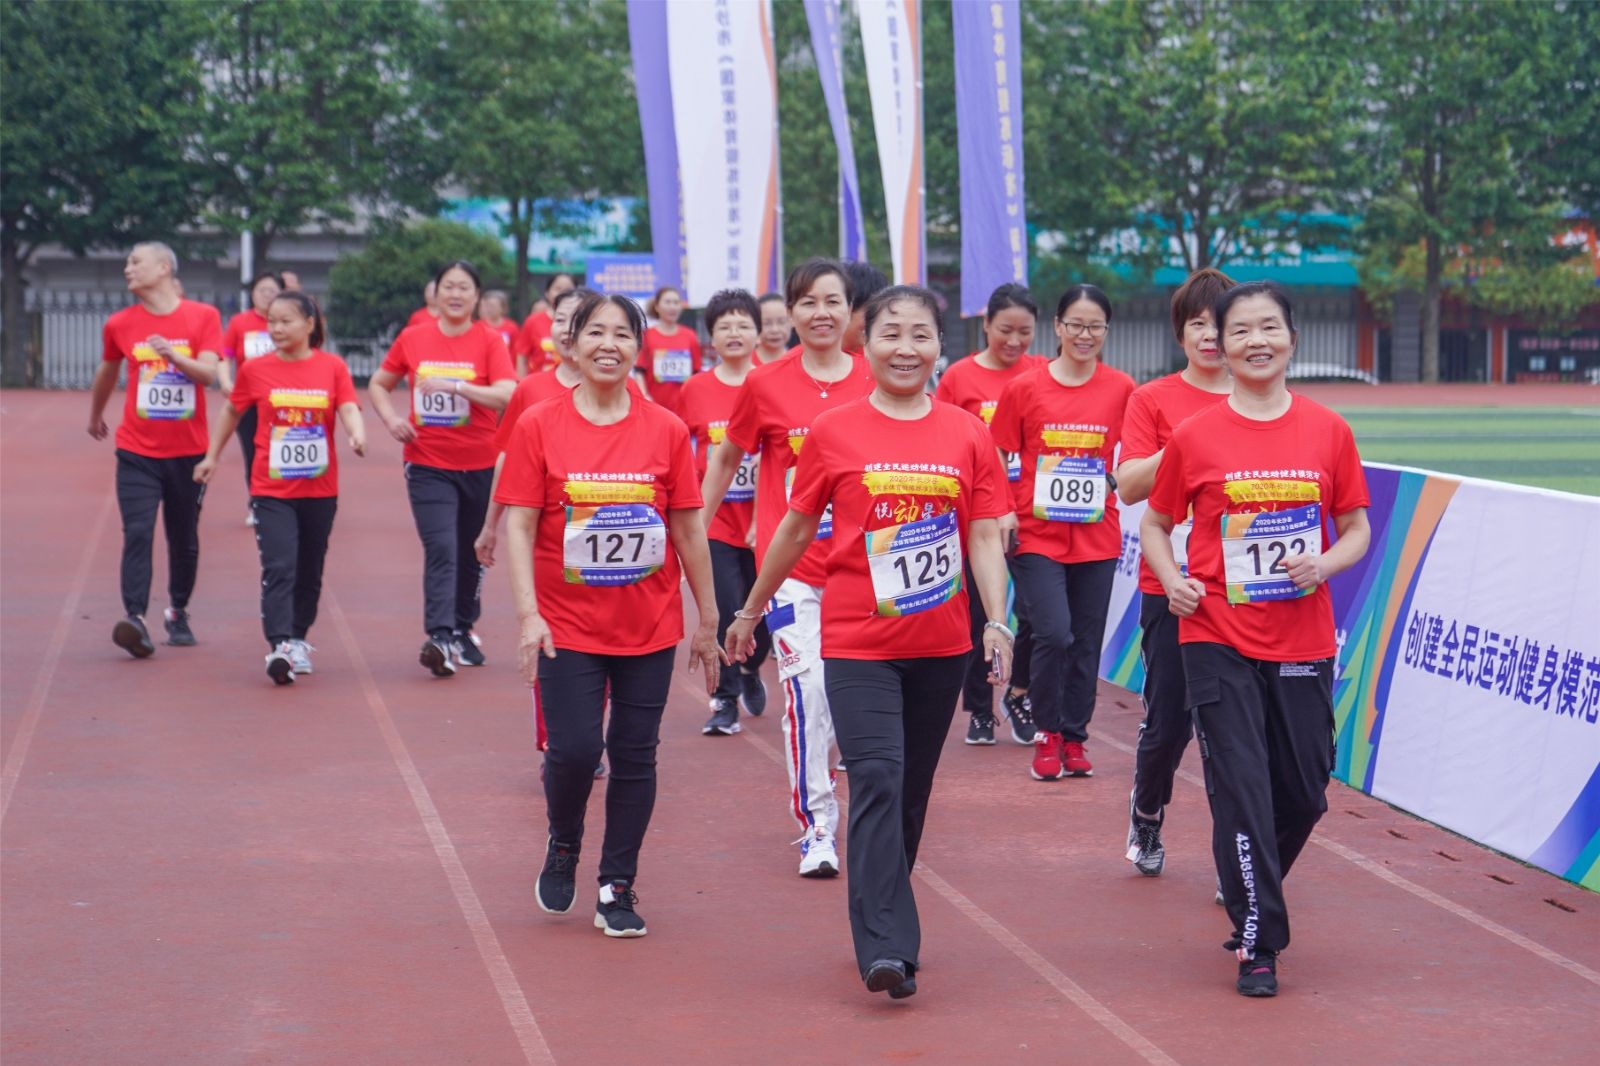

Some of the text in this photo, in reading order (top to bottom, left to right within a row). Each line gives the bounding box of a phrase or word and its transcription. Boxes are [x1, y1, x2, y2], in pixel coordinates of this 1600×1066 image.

[149, 387, 184, 406] 094
[422, 393, 456, 413] 091
[281, 443, 318, 464] 080
[1050, 478, 1094, 504] 089
[585, 533, 645, 563] 127
[894, 543, 951, 590] 125
[1404, 609, 1600, 724] 创建全民运动健身模范
